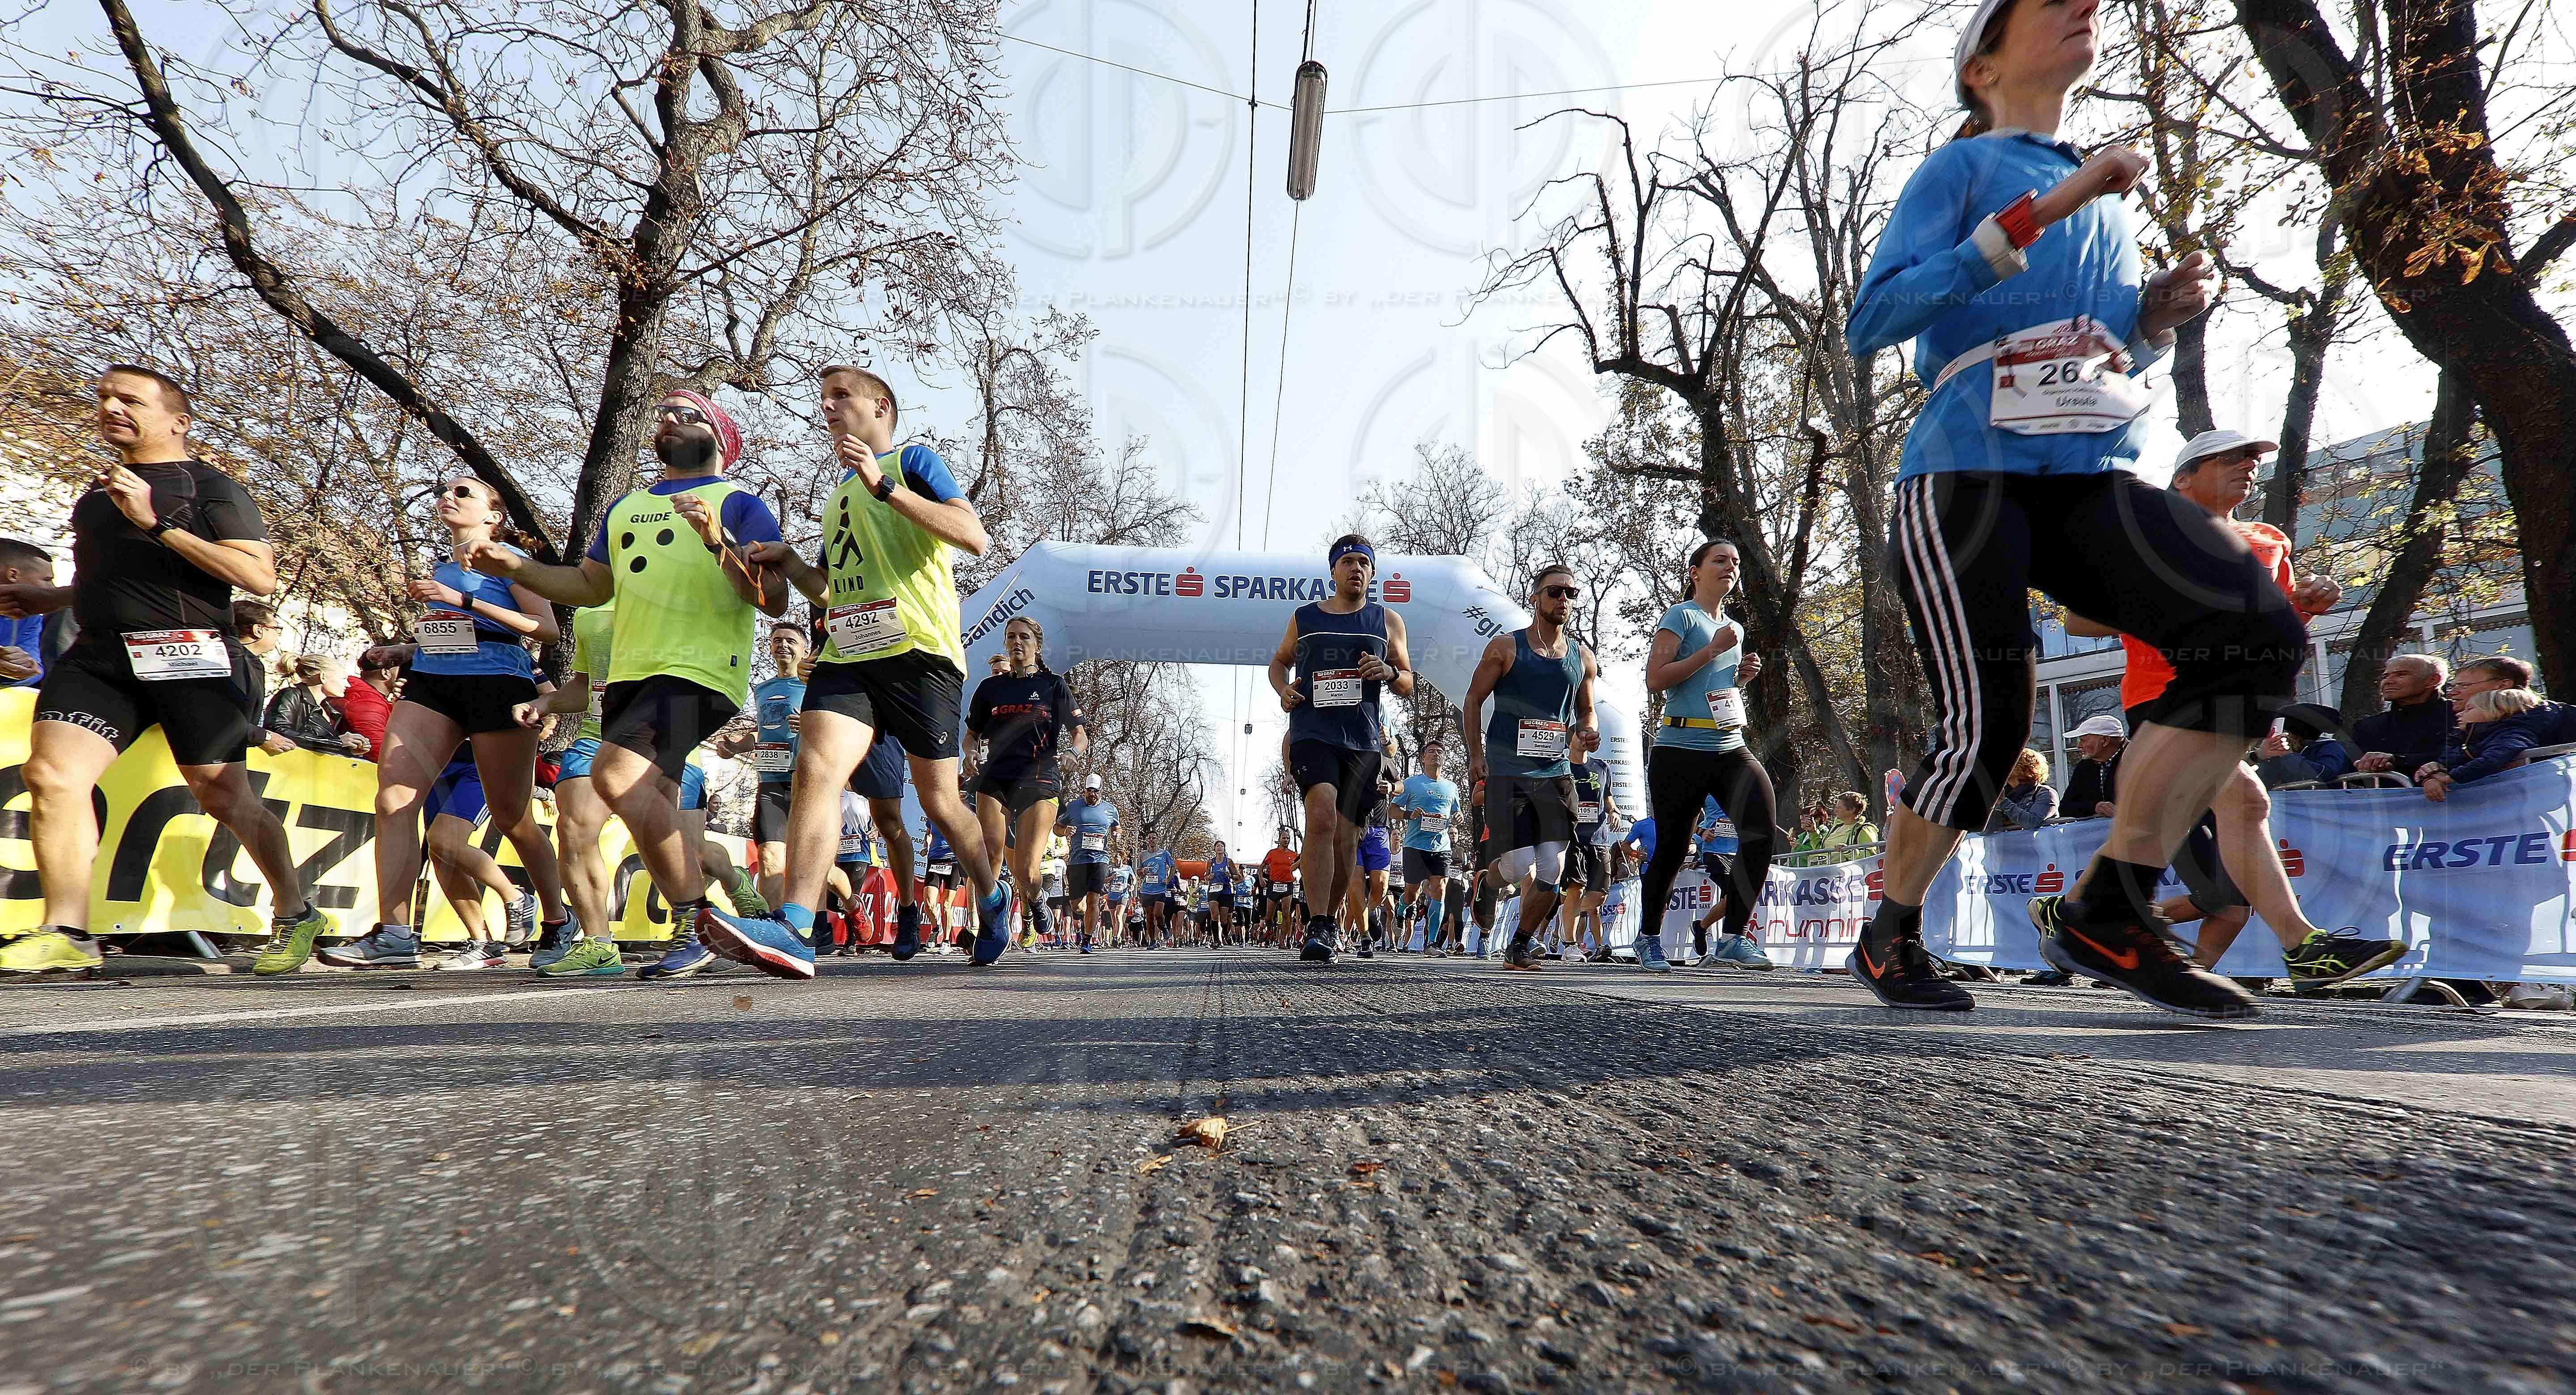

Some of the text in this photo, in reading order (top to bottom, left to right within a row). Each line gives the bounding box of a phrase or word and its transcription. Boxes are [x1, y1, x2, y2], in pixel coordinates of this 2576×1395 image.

[630, 512, 672, 523] GUIDE
[1087, 570, 1378, 602] ERSTE SPARKASE
[845, 612, 880, 629] 4292
[1462, 604, 1505, 639] #gl
[424, 622, 457, 634] 6855
[855, 630, 881, 640] Johannes
[155, 644, 202, 657] 4202
[1325, 681, 1348, 691] 2033
[1531, 731, 1554, 741] 4529
[761, 751, 778, 759] 2838
[2383, 832, 2551, 872] ERSTE
[1965, 873, 2033, 894] ERSTE
